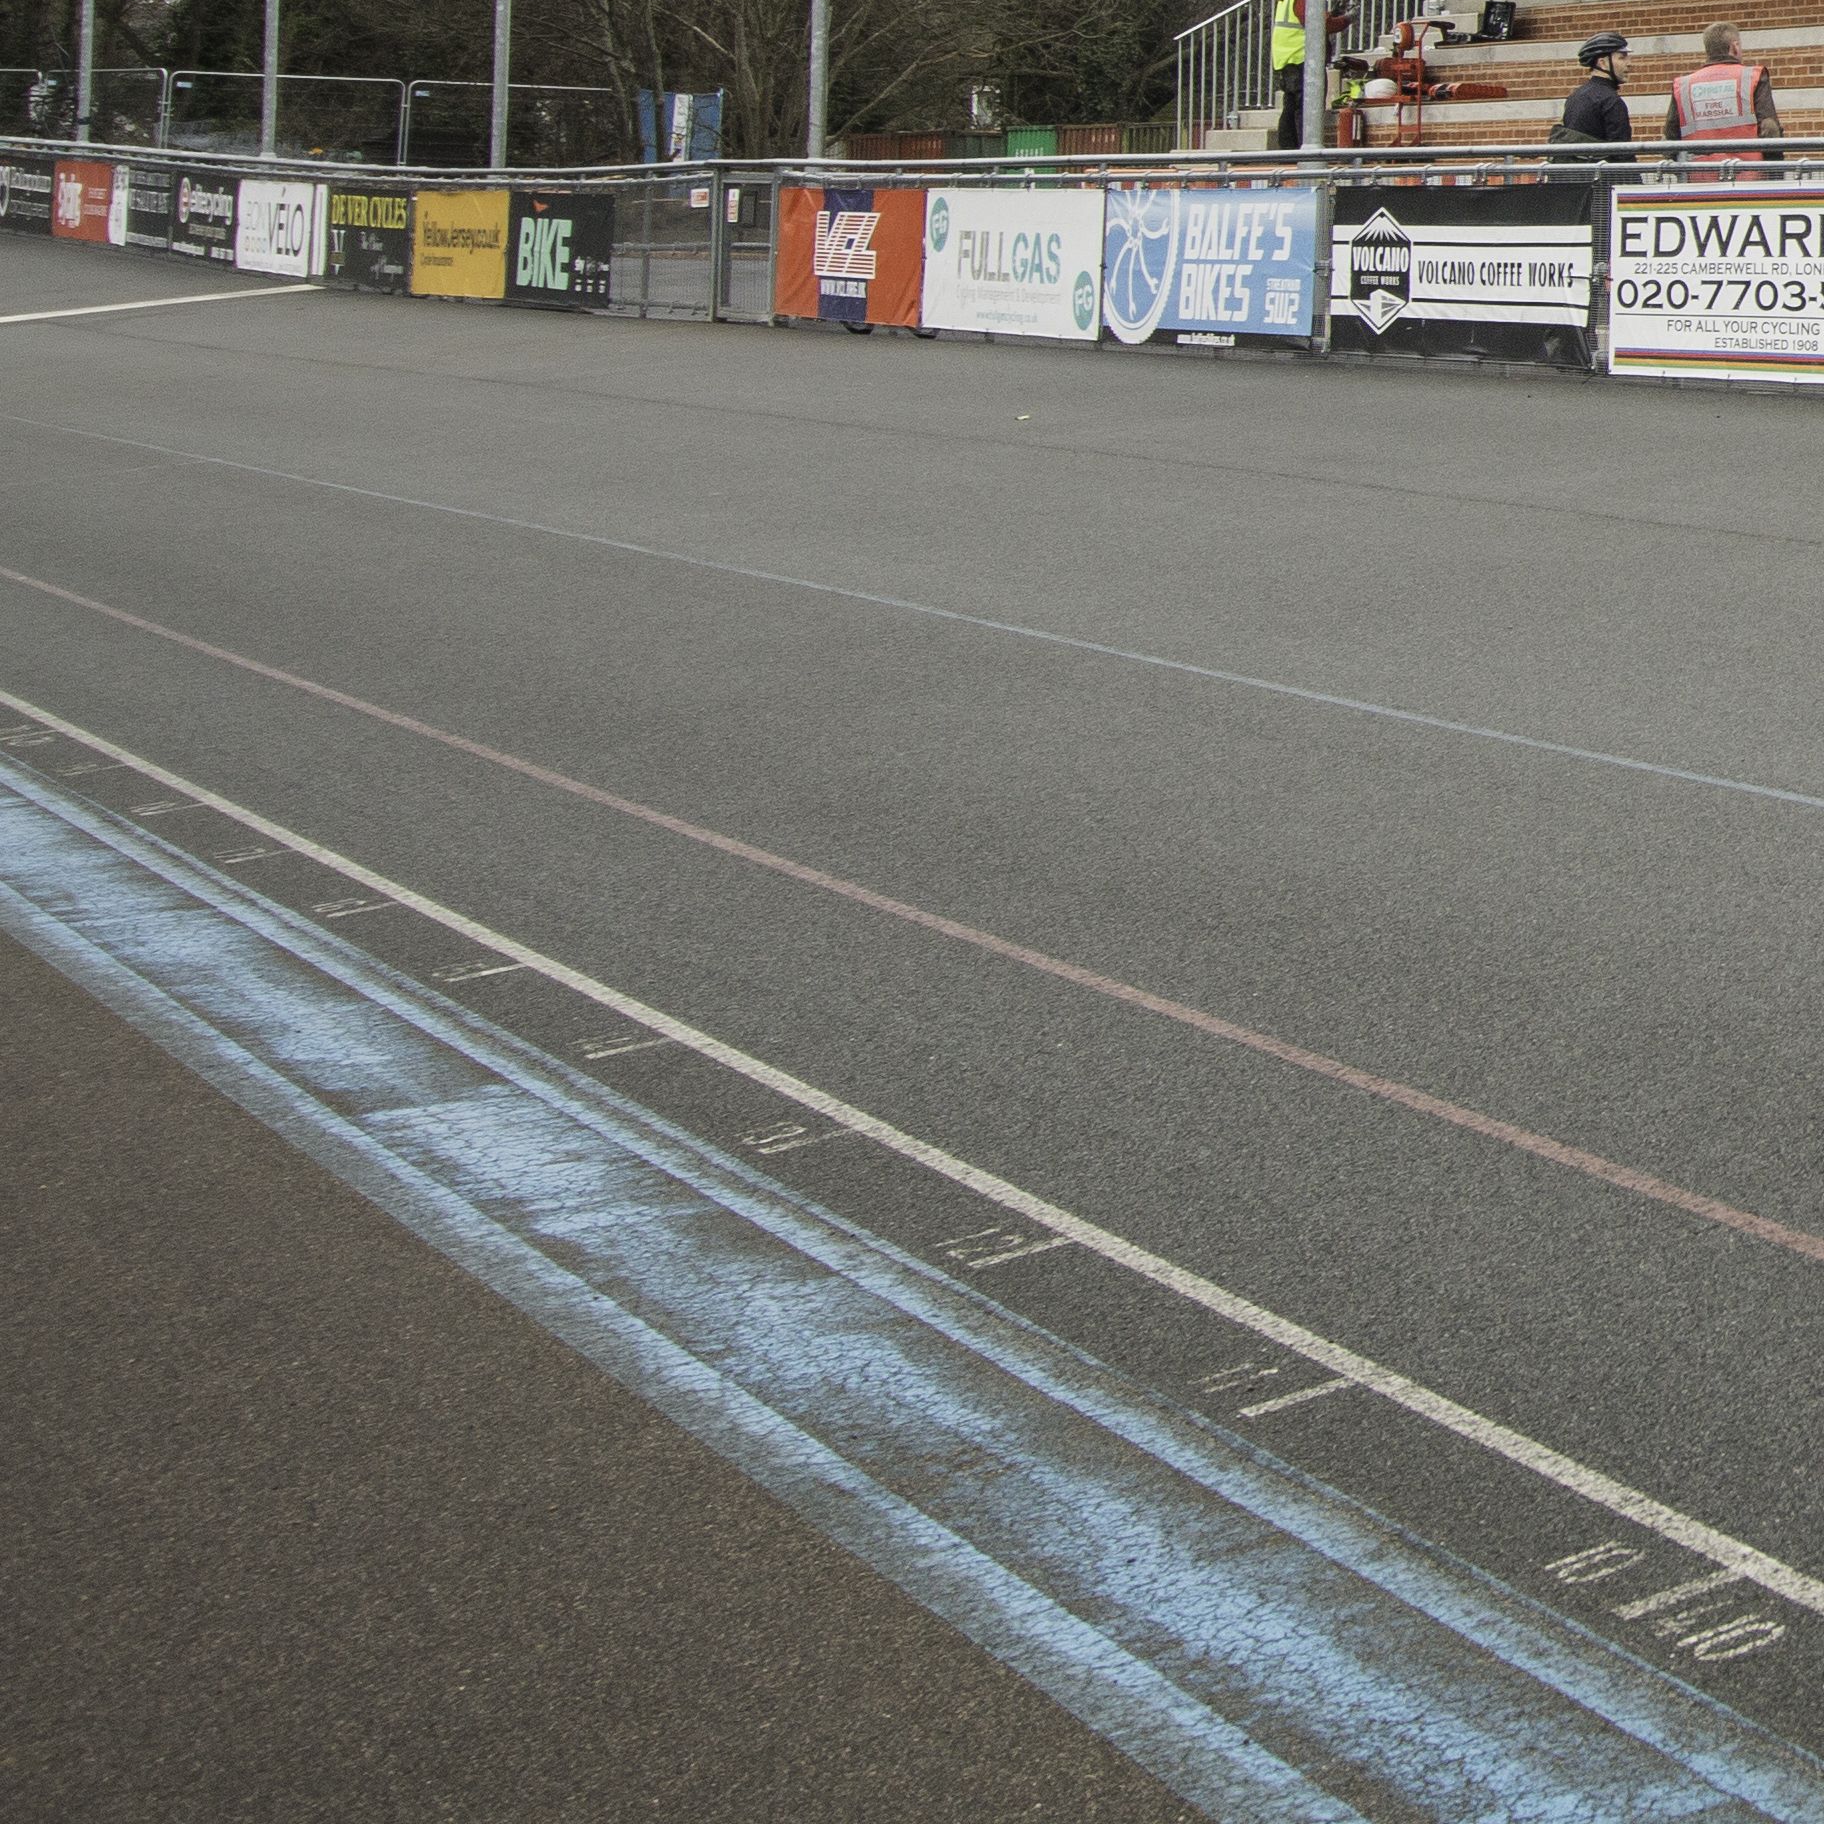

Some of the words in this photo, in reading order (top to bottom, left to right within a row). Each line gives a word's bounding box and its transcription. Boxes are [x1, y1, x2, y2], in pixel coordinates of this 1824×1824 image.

[1696, 108, 1734, 117] MARSHAL
[1704, 101, 1723, 109] FIRE
[268, 186, 305, 257] VÉLO
[369, 196, 408, 229] CYCLES
[932, 210, 948, 239] FG
[1184, 202, 1296, 261] BALFE'S
[516, 217, 572, 290] BIKE
[1352, 246, 1409, 273] VOLCANO
[1380, 276, 1400, 286] WORKS
[1417, 259, 1476, 285] VOLCANO
[1480, 261, 1523, 287] COFFEE
[1528, 262, 1574, 288] WORKS
[1633, 262, 1679, 275] 221-225
[1681, 262, 1768, 276] CAMBERWELL
[1074, 284, 1093, 317] FG
[1179, 263, 1253, 322] BIKES
[1666, 319, 1693, 333] FOR
[1695, 319, 1720, 333] ALL
[1723, 320, 1760, 334] YOUR
[1761, 321, 1821, 336] CYCLING
[1714, 337, 1789, 351] ESTABLISHED
[1792, 338, 1819, 352] 1908
